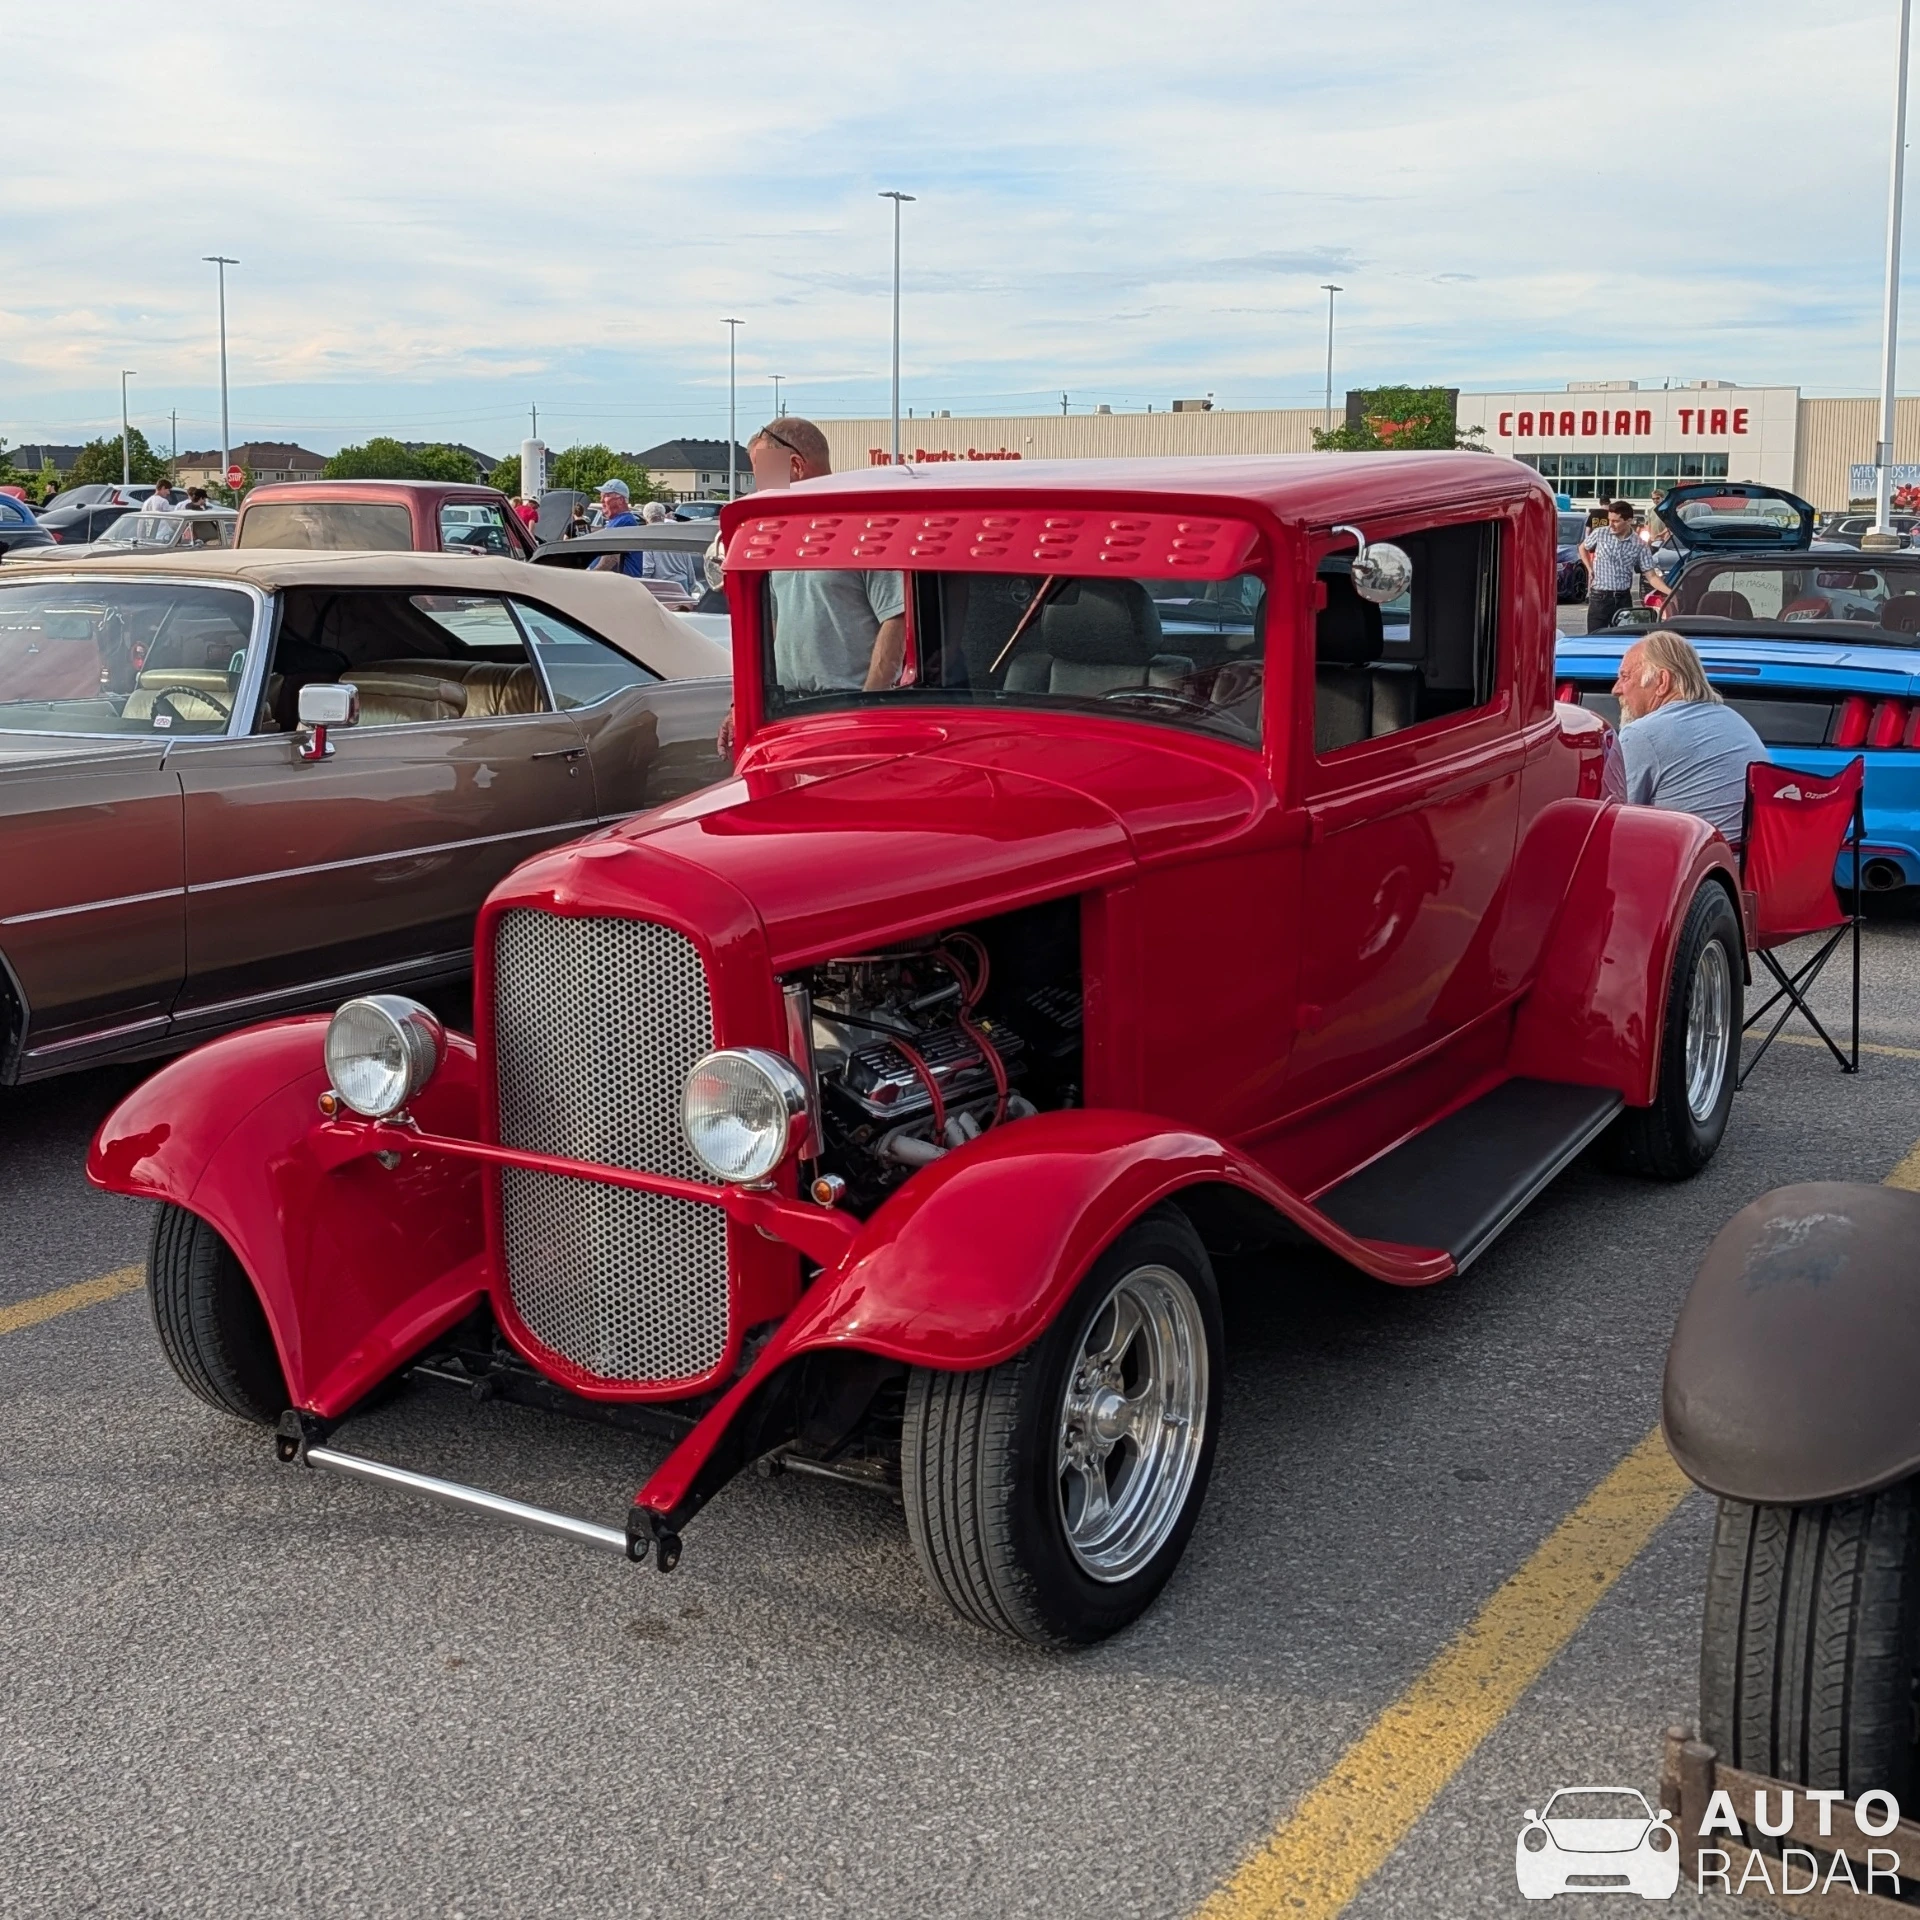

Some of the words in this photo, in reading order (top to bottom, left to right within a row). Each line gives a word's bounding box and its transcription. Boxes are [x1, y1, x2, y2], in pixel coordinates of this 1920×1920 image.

[1499, 410, 1651, 436] CANADIAN
[1678, 409, 1749, 434] TIRE
[869, 449, 905, 465] Tirs
[916, 449, 956, 463] Parts
[968, 447, 1022, 461] Service
[228, 473, 242, 481] STOP
[1851, 465, 1878, 478] WHEN
[1852, 479, 1876, 491] THEY
